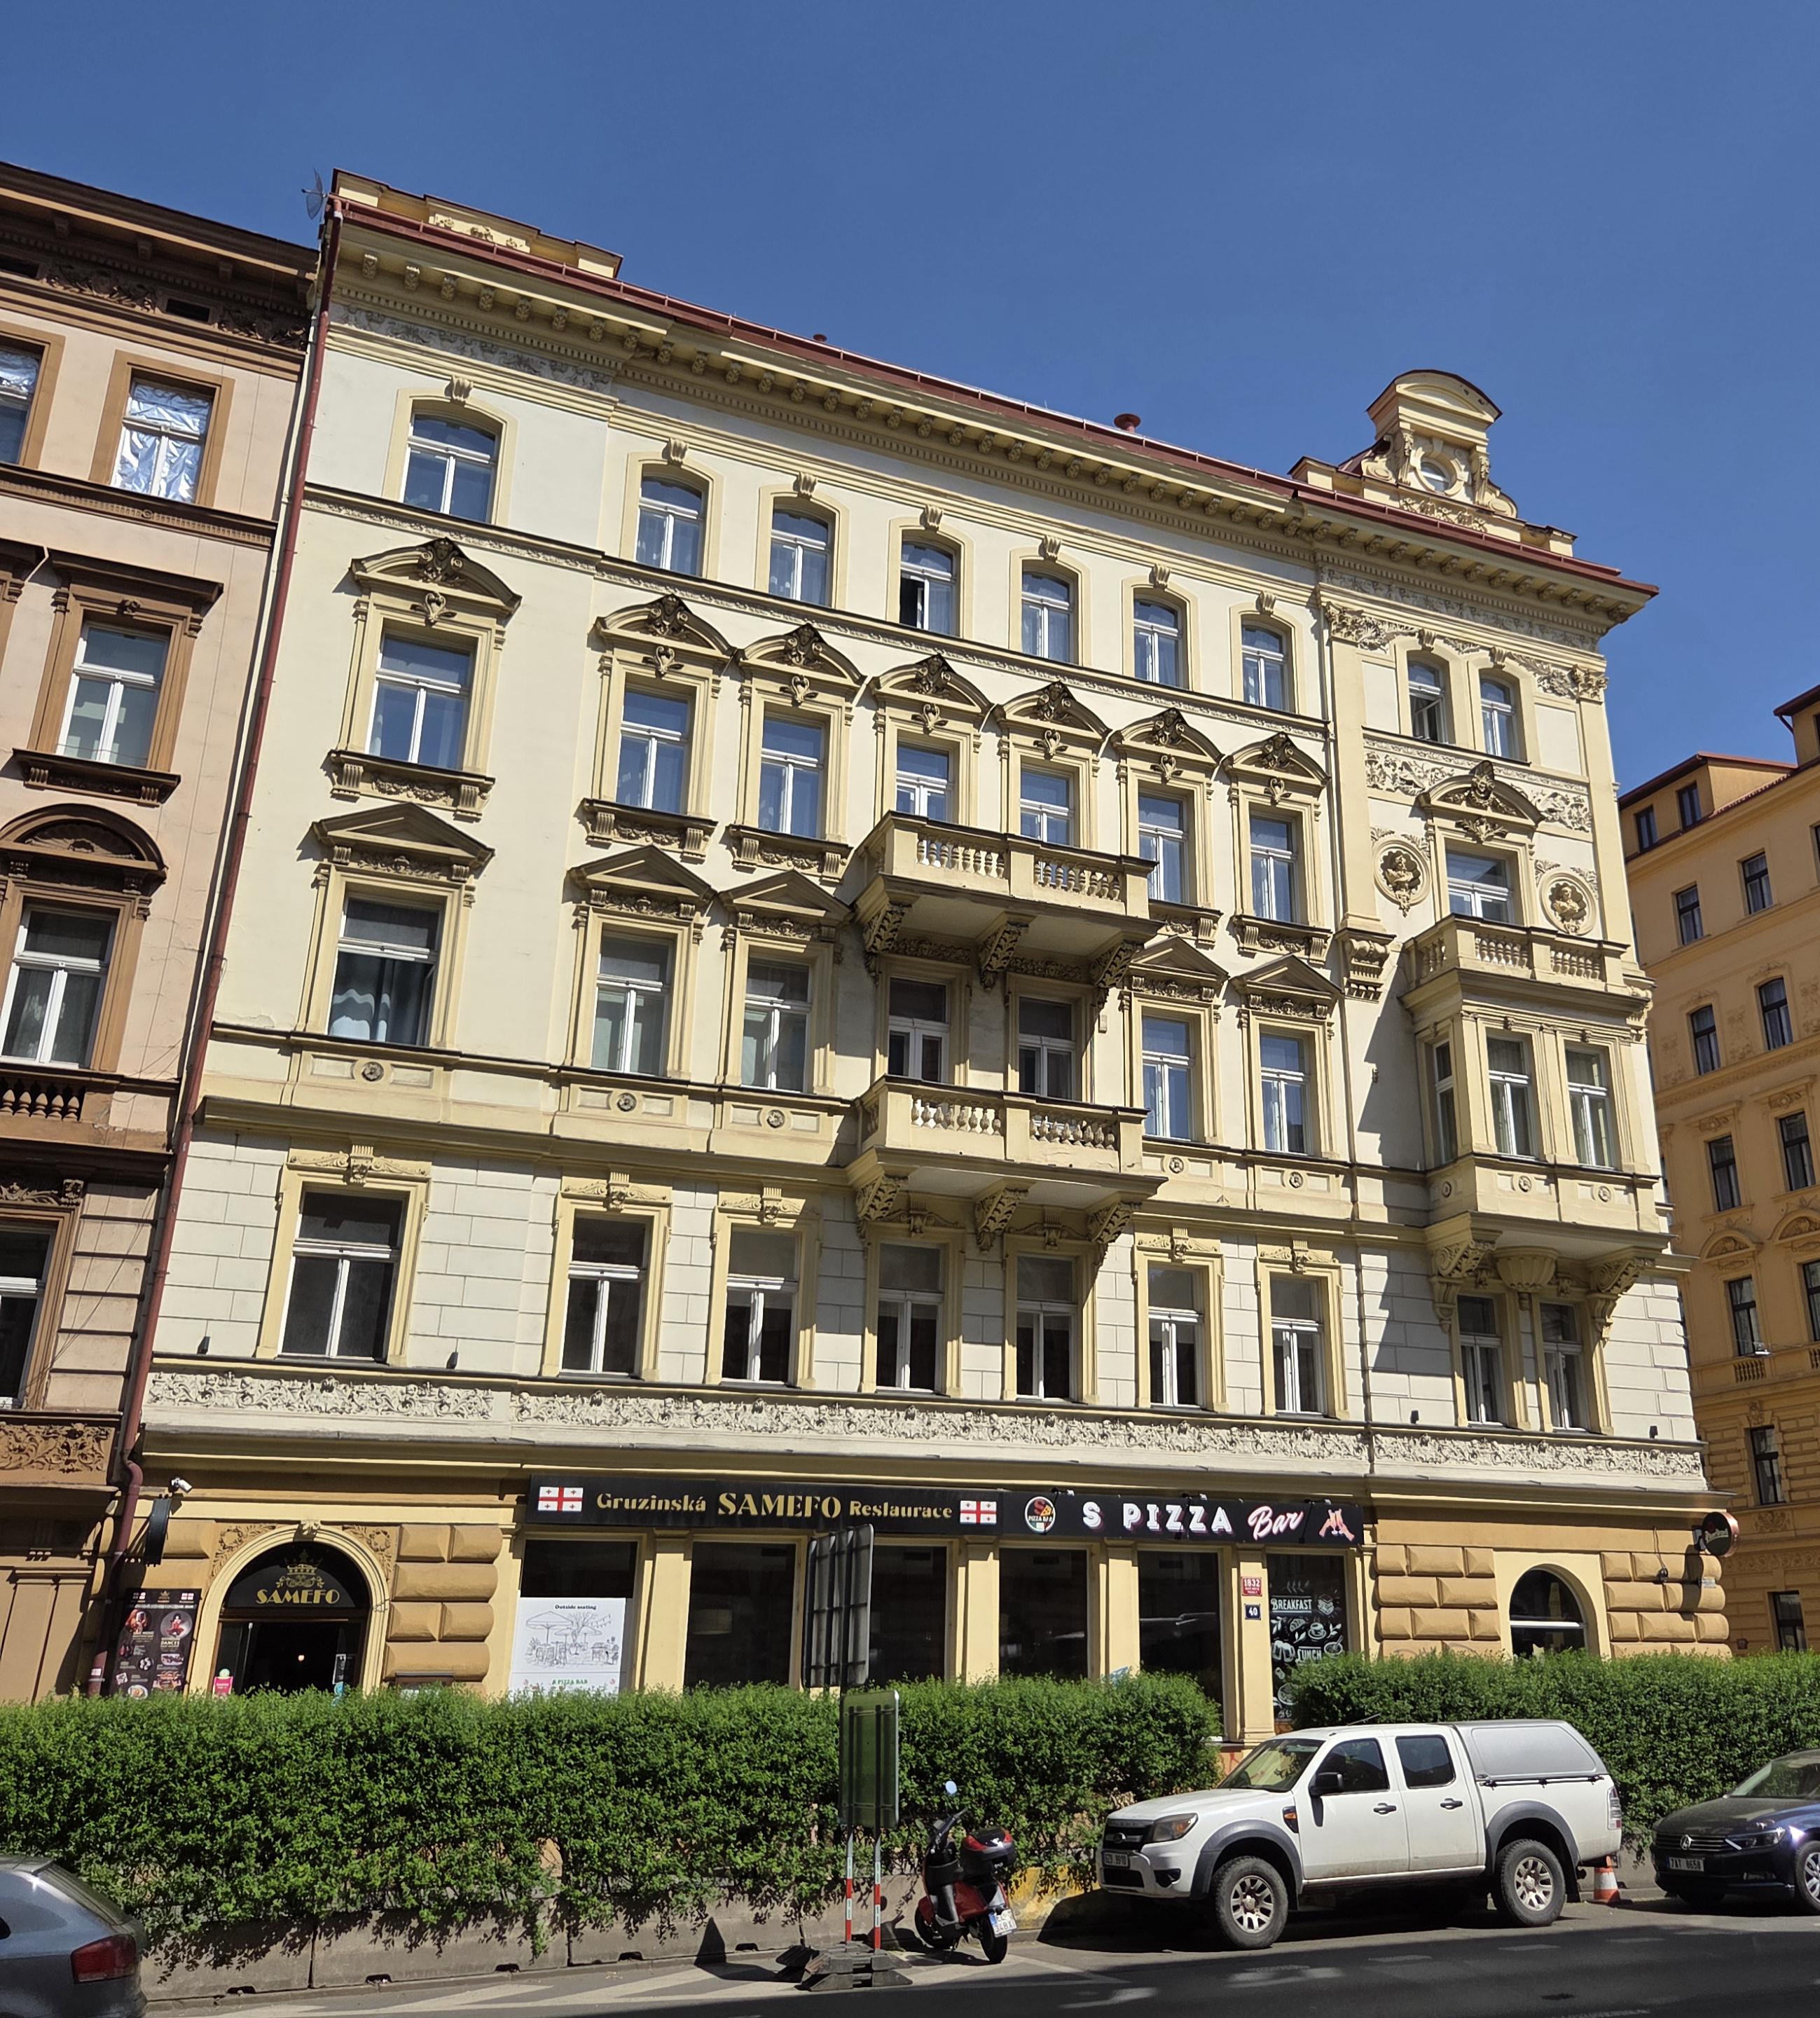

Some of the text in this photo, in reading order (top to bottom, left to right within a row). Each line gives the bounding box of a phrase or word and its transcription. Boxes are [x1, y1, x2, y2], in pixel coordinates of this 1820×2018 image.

[597, 1492, 953, 1518] Gruzinská SAMEFO Restaurace
[1082, 1502, 1304, 1541] S PIZZA Bar
[1243, 1578, 1260, 1587] 1832
[256, 1588, 340, 1605] SAMEFO
[1271, 1598, 1312, 1610] BREAKFAST
[1248, 1607, 1258, 1617] 40
[1295, 1648, 1322, 1663] LUNCH
